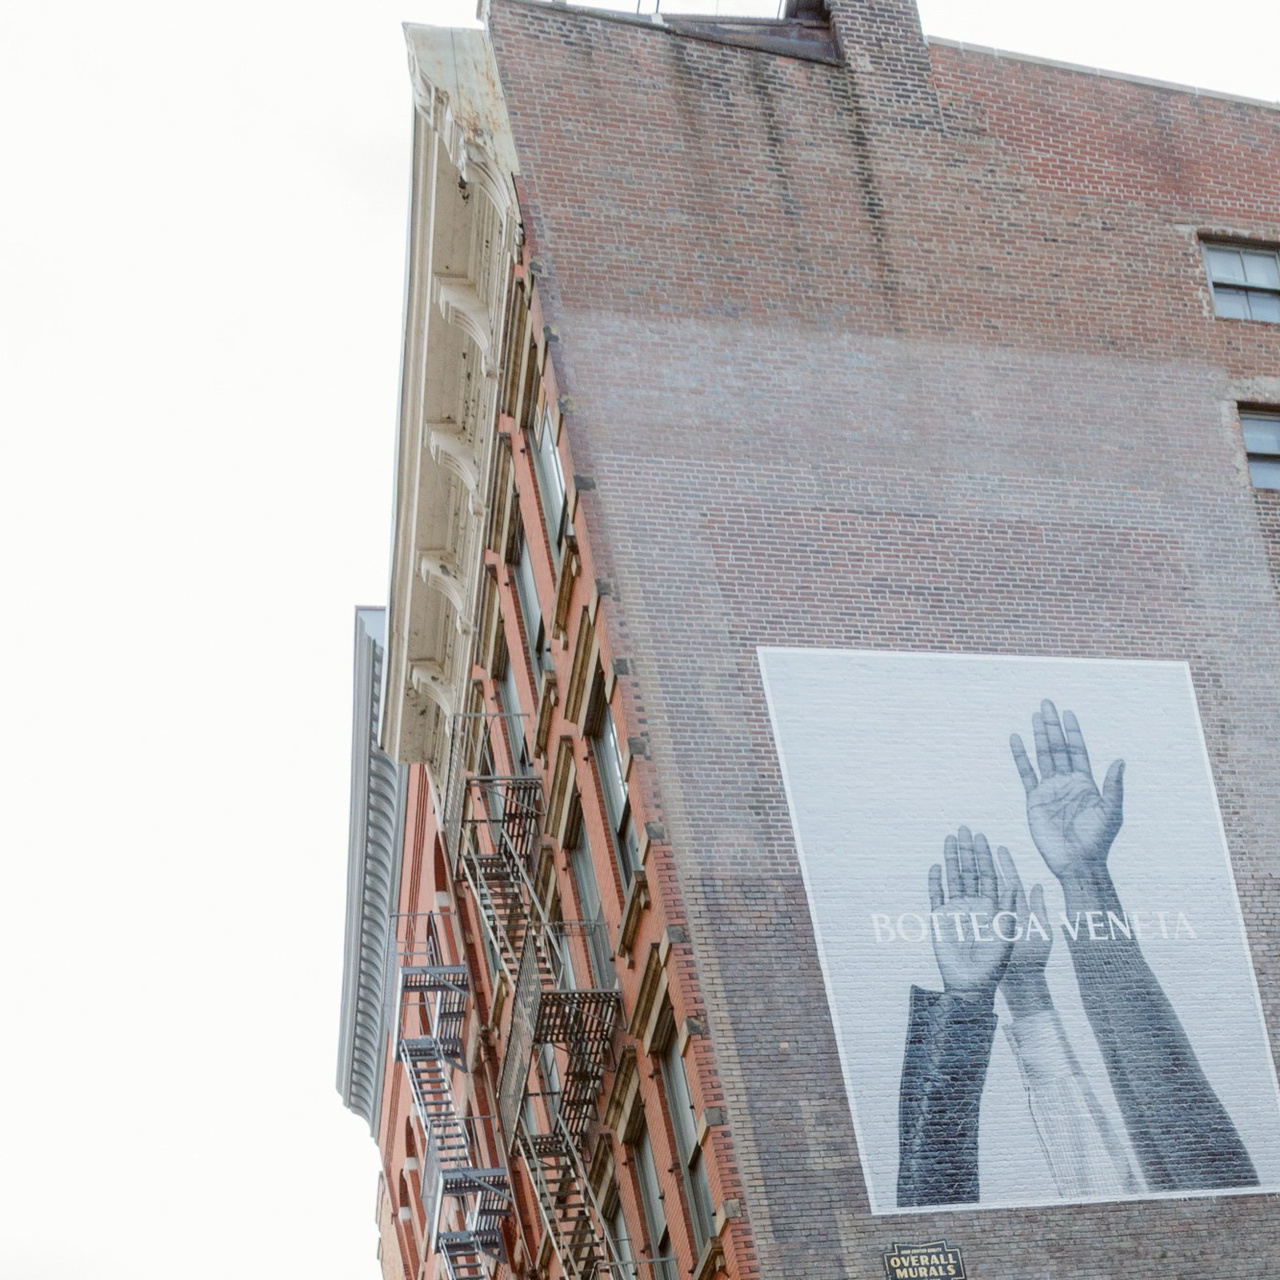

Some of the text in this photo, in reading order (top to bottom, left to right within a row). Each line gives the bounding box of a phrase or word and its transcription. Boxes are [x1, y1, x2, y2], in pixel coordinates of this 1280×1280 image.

[870, 910, 1198, 943] BOTTEGA VENETA
[890, 1253, 957, 1268] OVERALL
[895, 1264, 956, 1279] MURALS
